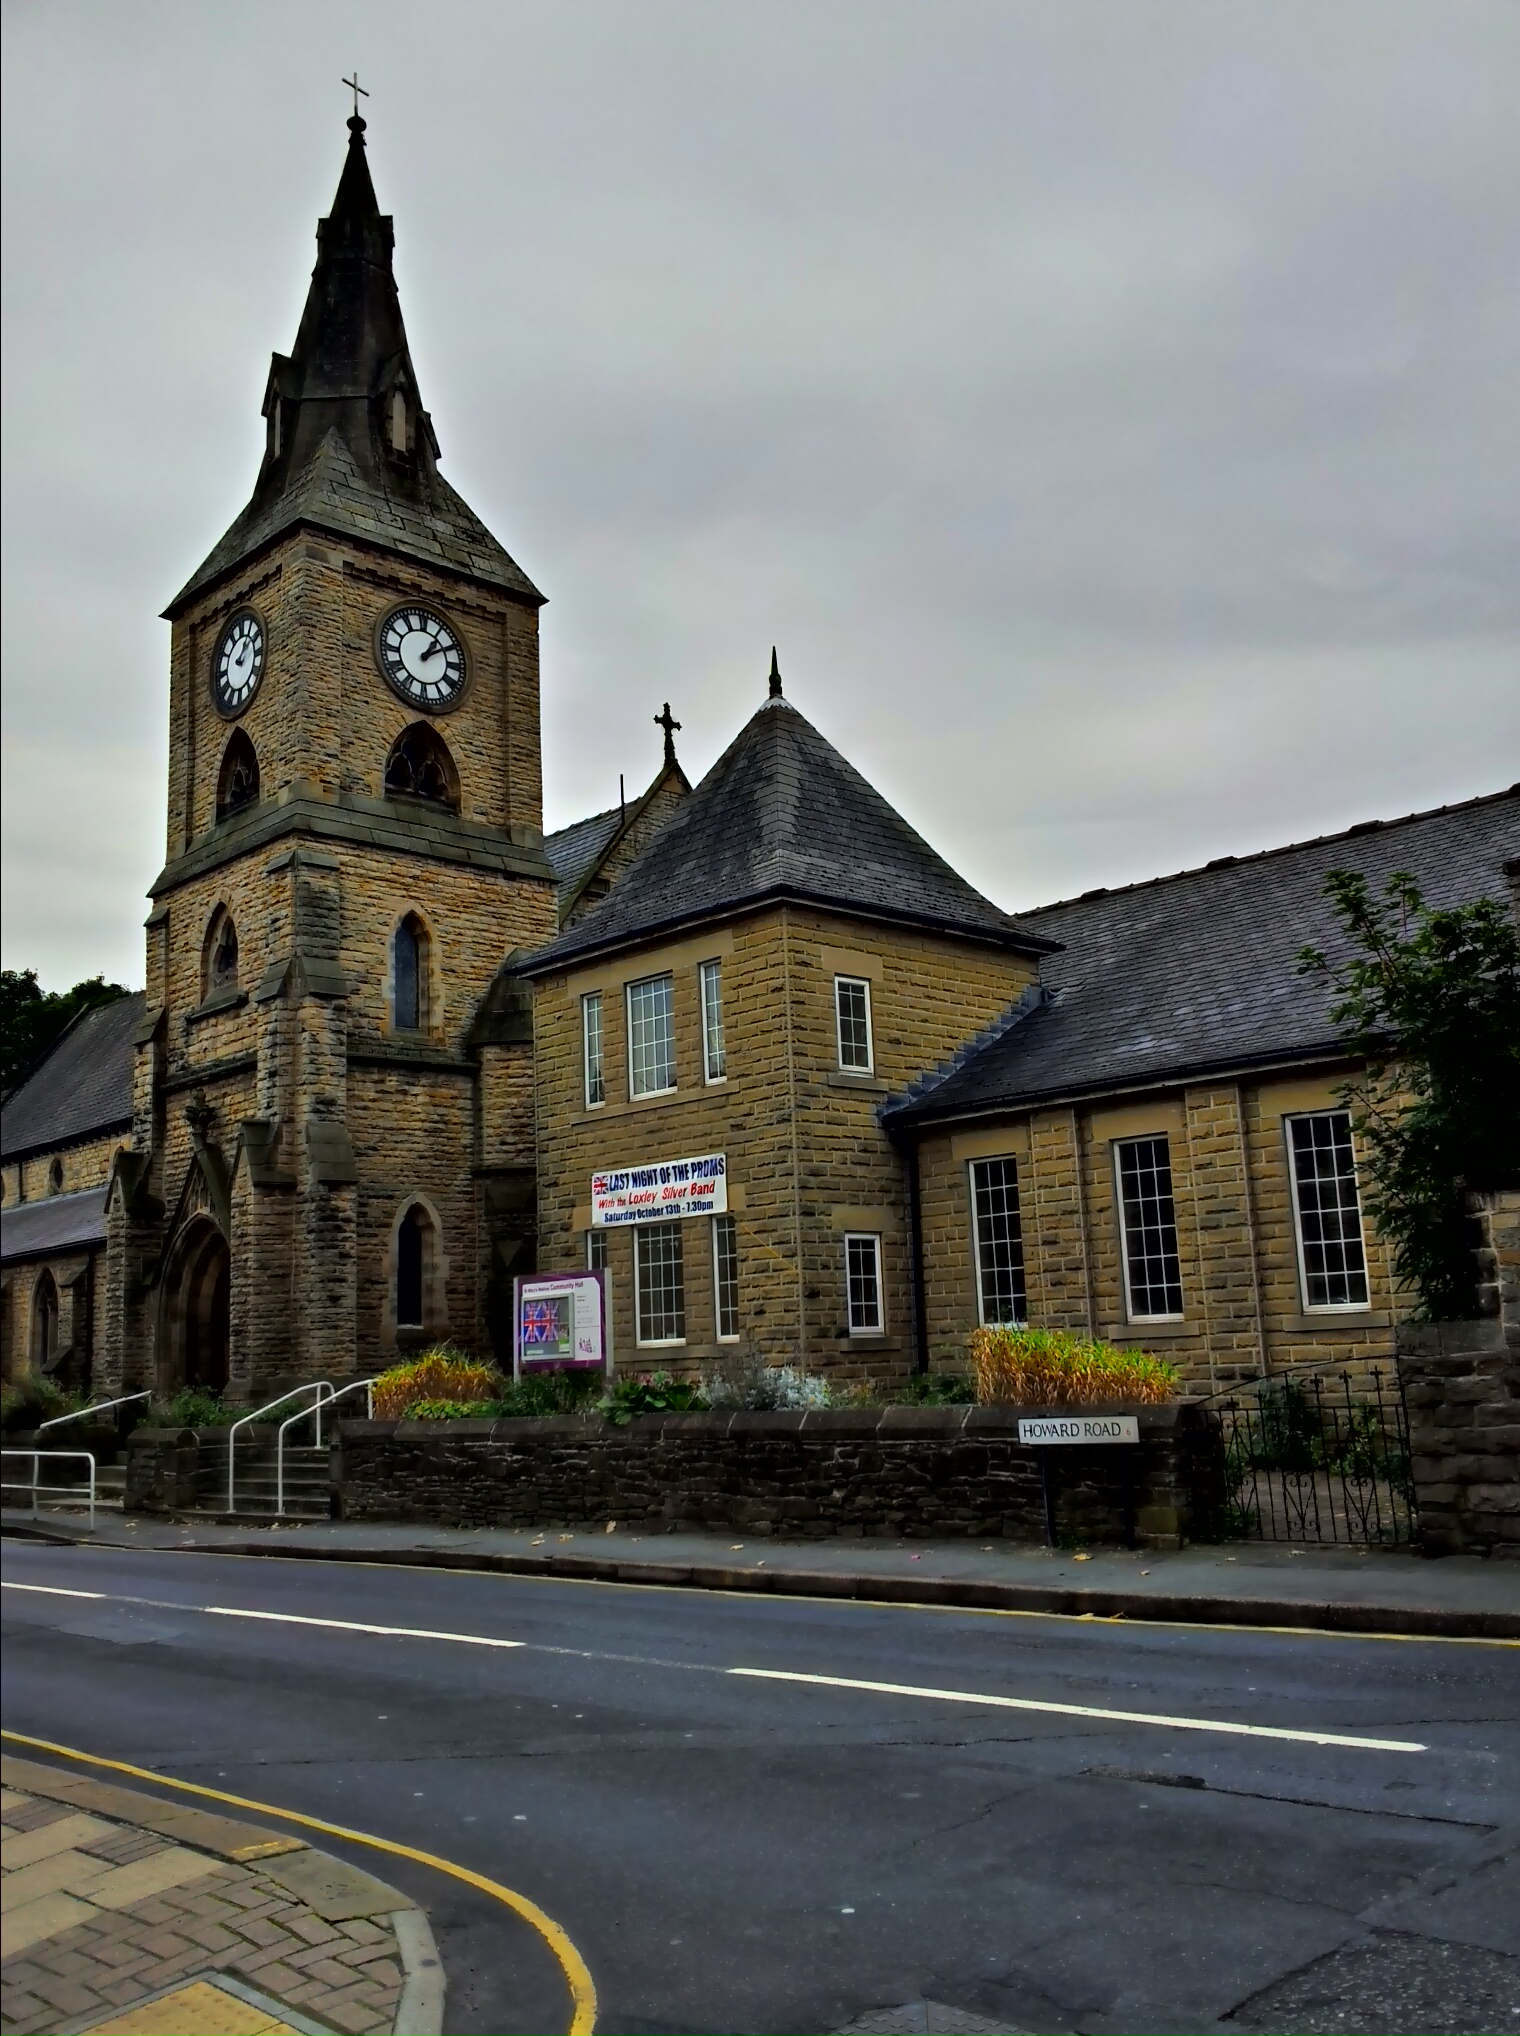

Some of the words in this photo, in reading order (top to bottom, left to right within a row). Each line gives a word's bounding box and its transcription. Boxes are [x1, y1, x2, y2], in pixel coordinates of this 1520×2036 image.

[609, 1172, 630, 1192] LAST
[631, 1168, 658, 1188] NIGHT
[660, 1166, 671, 1185] OF
[672, 1163, 689, 1182] THE
[690, 1157, 725, 1179] PROMS
[598, 1198, 615, 1209] With
[617, 1197, 626, 1207] the
[628, 1190, 658, 1205] Loxley
[662, 1186, 687, 1200] Silver
[690, 1180, 716, 1196] Band
[604, 1209, 637, 1223] Saturday
[637, 1206, 664, 1218] October
[665, 1203, 681, 1215] 13th
[550, 1283, 574, 1291] Community
[1023, 1423, 1080, 1438] HOWARD
[1084, 1422, 1122, 1437] ROAD
